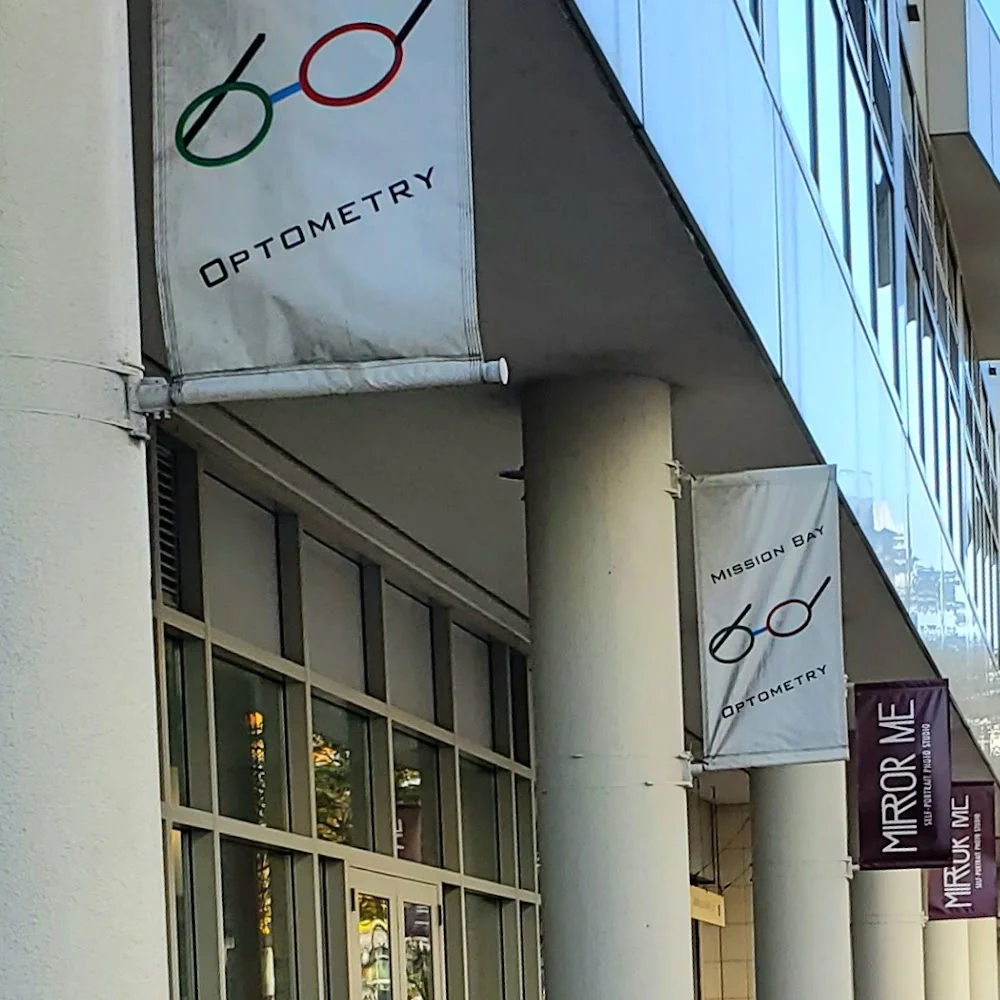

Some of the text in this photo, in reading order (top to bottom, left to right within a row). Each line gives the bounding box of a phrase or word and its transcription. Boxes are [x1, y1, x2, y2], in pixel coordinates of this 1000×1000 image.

[199, 165, 435, 288] OPTOMETRY
[710, 524, 826, 584] MISSION BAY
[720, 664, 828, 719] OPTOMETRY
[921, 723, 931, 748] STUDIO
[922, 749, 932, 773] PHOTO
[877, 699, 918, 853] MIRROR ME
